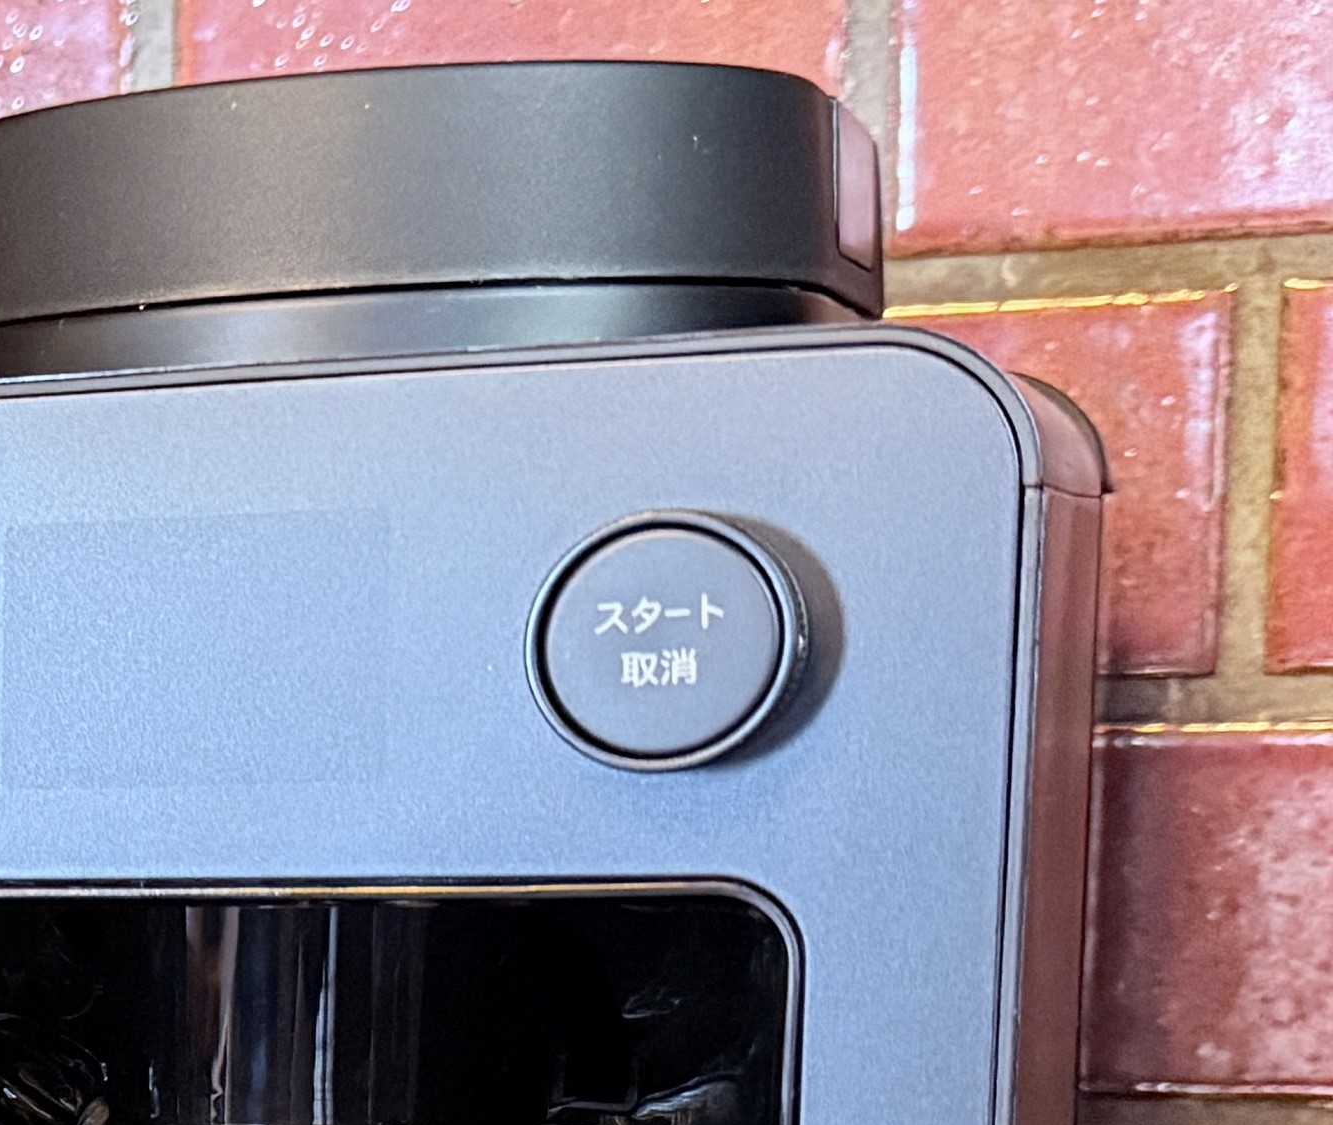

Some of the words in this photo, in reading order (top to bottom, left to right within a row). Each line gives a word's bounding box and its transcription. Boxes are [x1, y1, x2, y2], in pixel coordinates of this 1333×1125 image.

[594, 592, 725, 635] スタート
[620, 648, 698, 688] 取消
